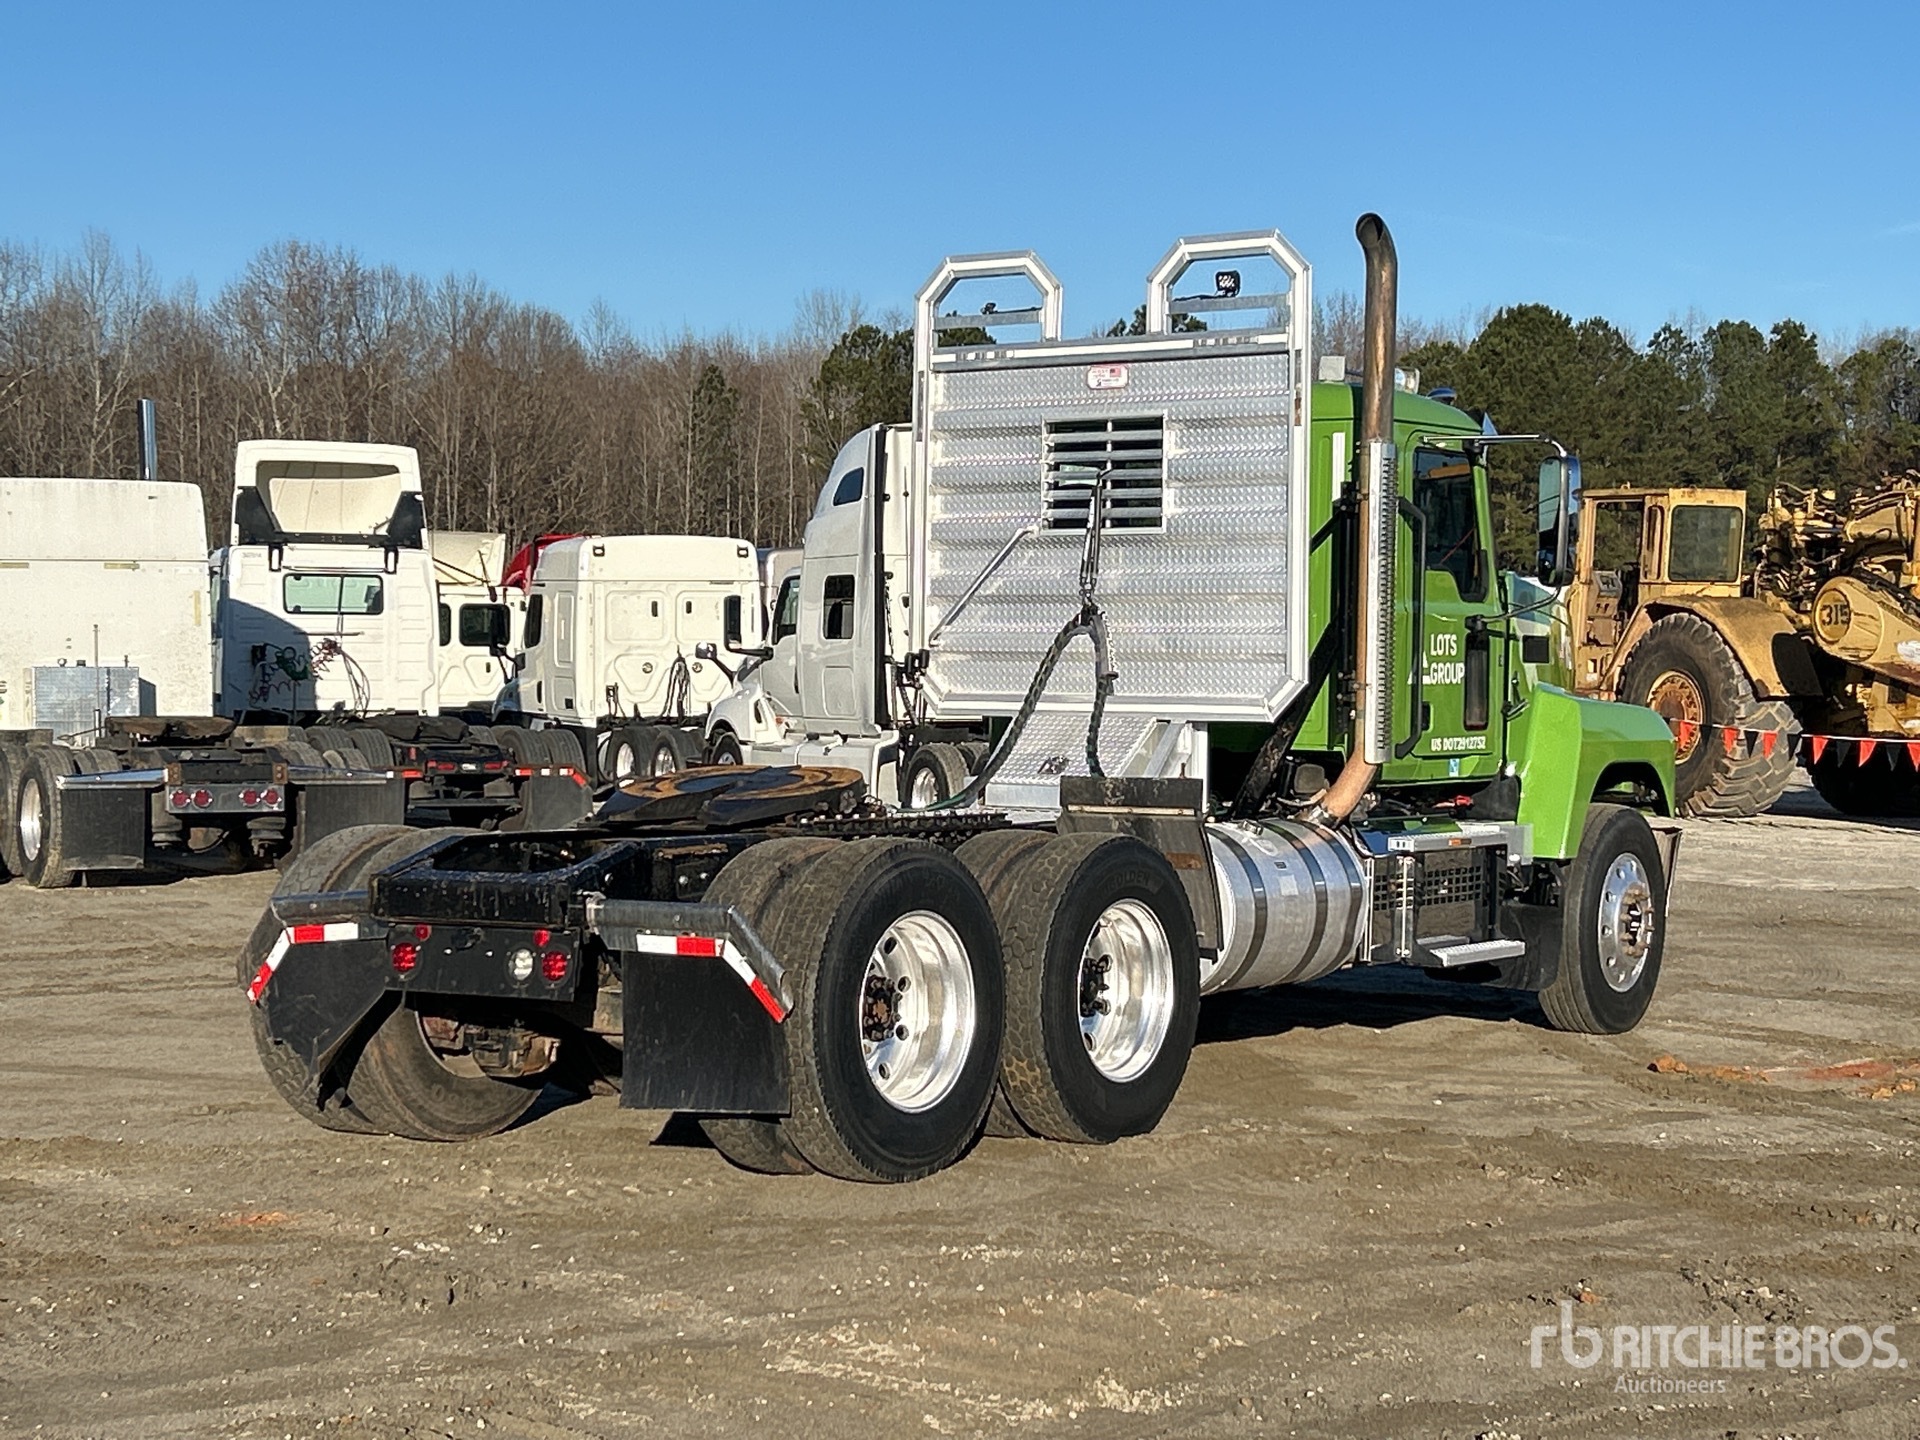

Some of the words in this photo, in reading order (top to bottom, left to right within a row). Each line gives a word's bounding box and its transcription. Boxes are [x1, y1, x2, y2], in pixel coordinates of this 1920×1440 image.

[1820, 604, 1849, 626] 315
[1430, 633, 1457, 656] LOTS
[1430, 662, 1465, 684] GROUP
[1431, 737, 1442, 751] US
